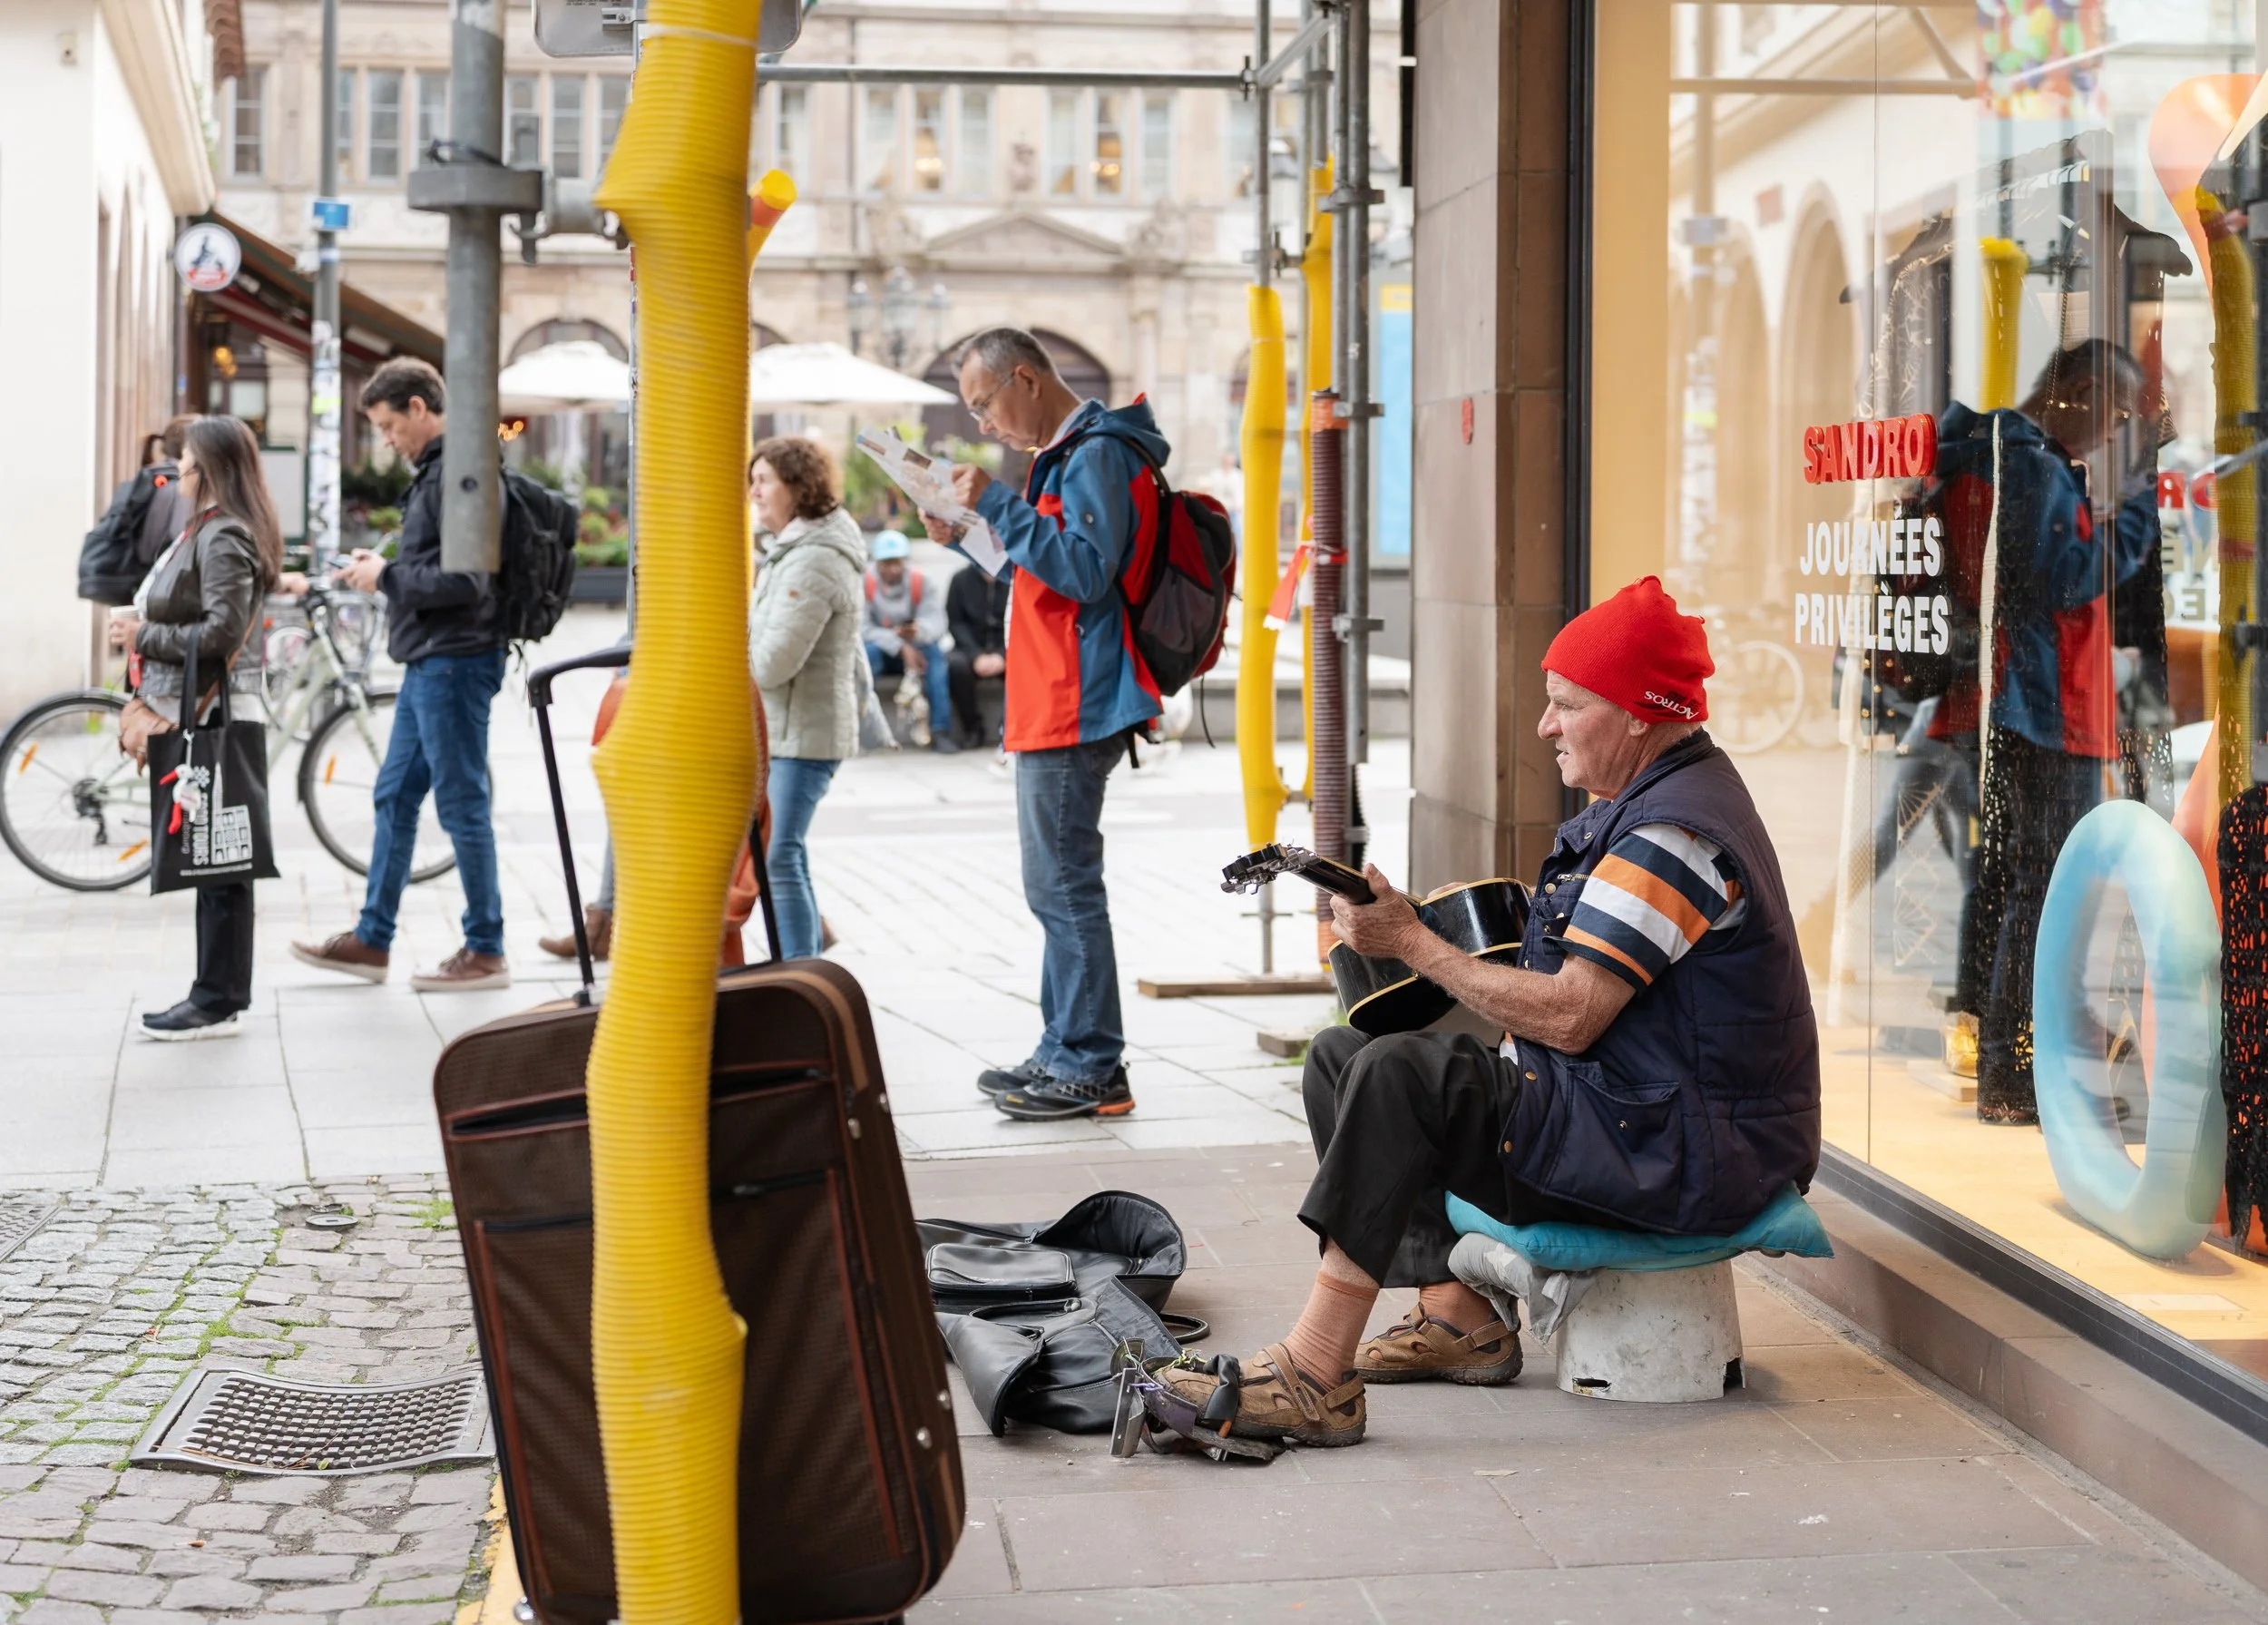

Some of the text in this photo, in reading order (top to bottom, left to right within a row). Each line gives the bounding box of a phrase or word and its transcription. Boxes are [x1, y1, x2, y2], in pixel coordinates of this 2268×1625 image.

[1804, 413, 1936, 485] SANDRO
[1800, 504, 1941, 576] JOURNÉES
[1794, 581, 1950, 655] PRIVILÈGES
[1644, 690, 1699, 720] ACTROS
